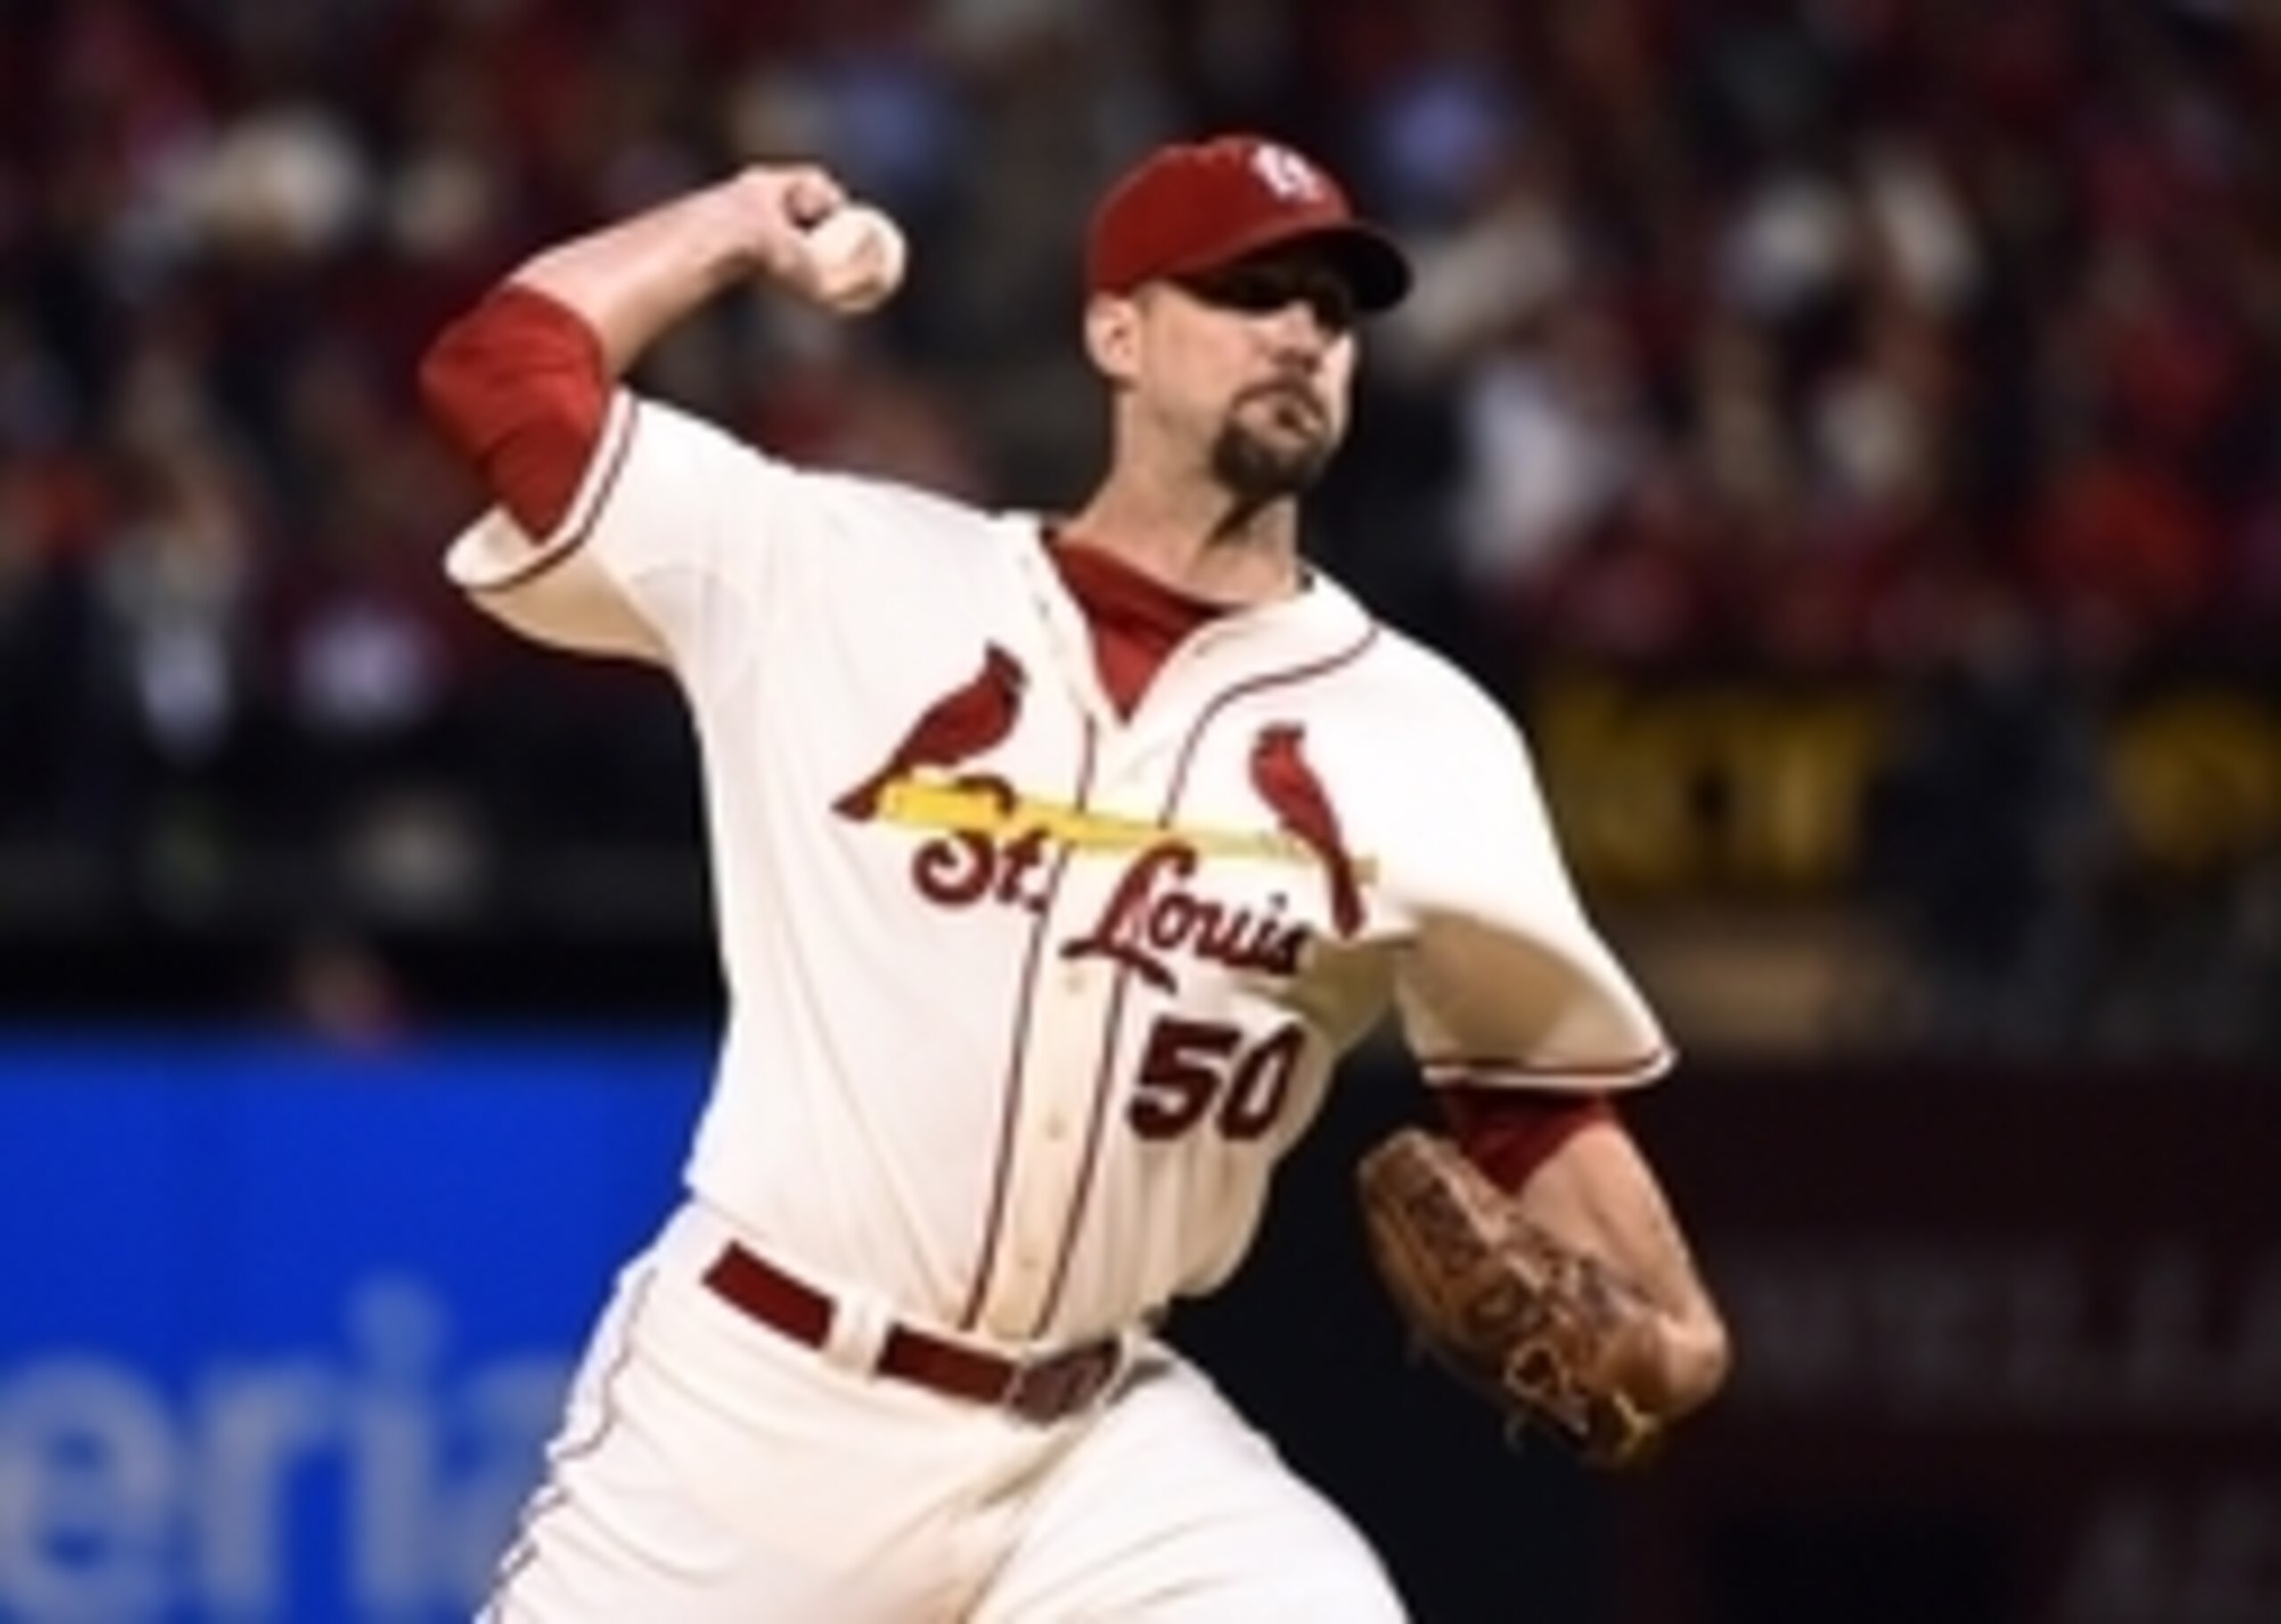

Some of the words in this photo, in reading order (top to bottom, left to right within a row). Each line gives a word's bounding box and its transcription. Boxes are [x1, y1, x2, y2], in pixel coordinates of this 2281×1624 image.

[911, 773, 1049, 912] St.
[1059, 836, 1315, 996] Louis
[1126, 1015, 1306, 1142] 50
